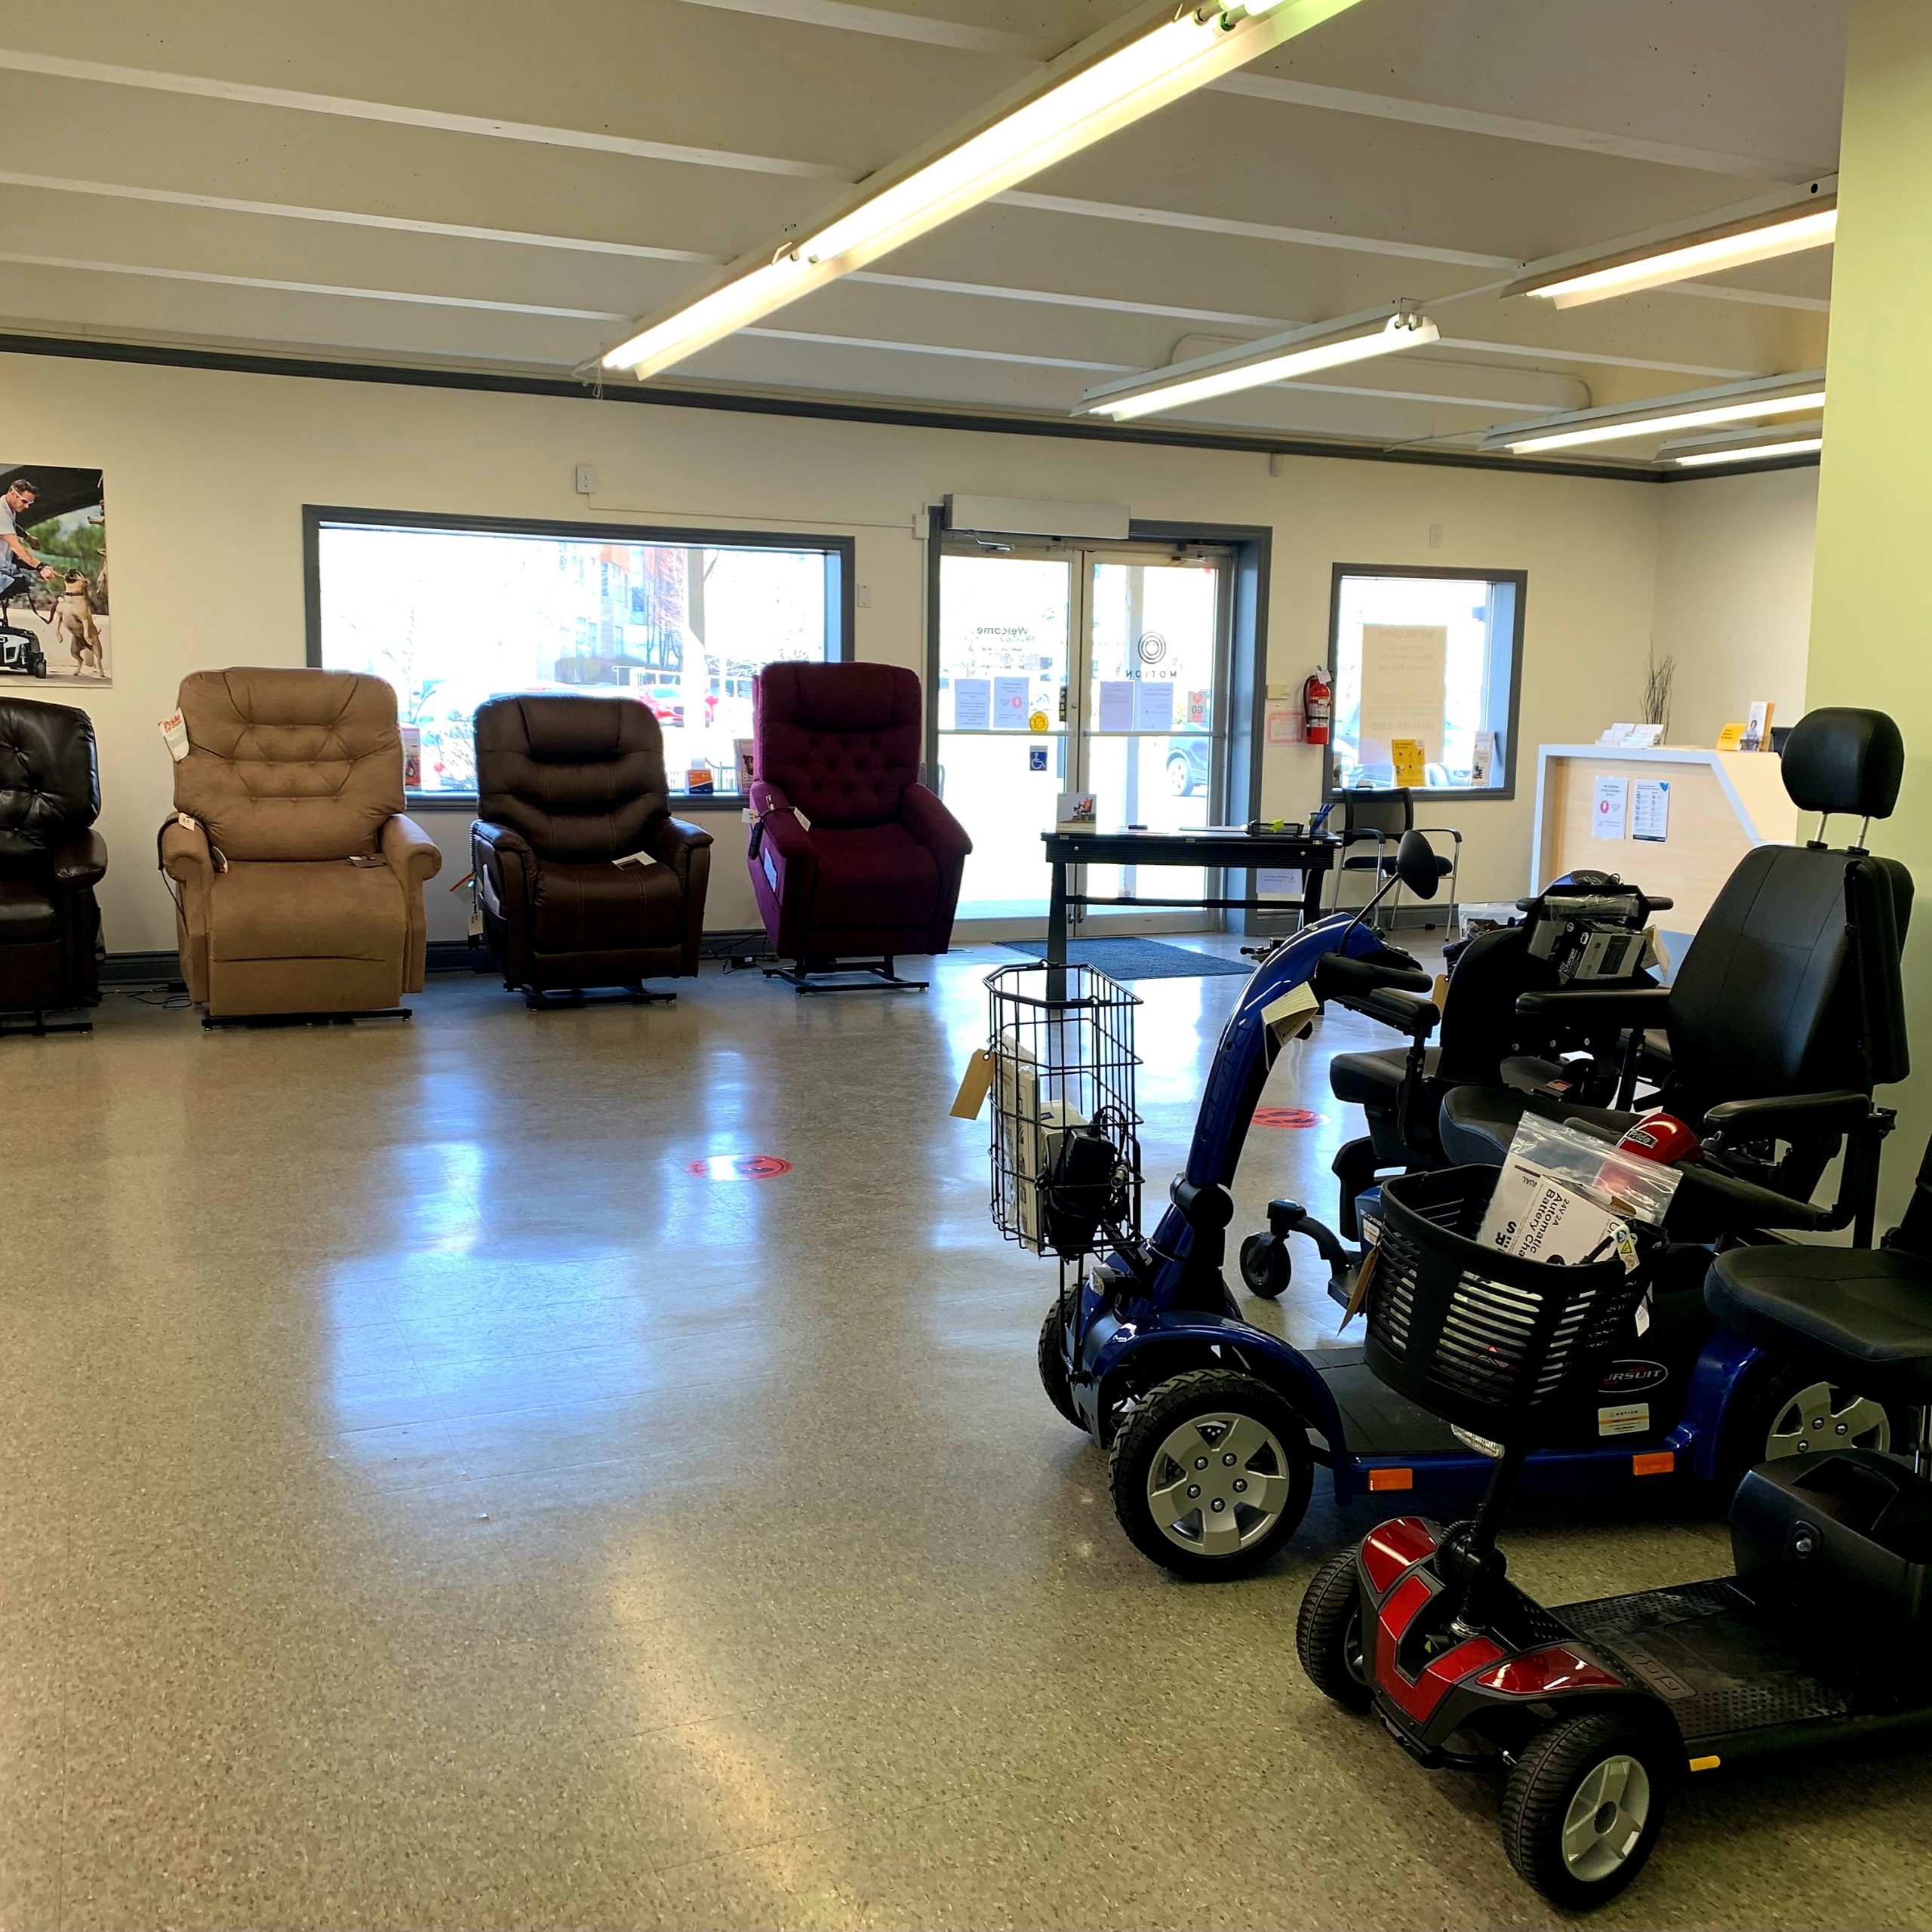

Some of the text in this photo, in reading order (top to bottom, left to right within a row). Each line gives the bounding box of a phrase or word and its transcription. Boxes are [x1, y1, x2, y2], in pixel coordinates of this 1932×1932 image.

[1563, 948, 1576, 973] Charger
[1628, 1131, 1651, 1143] Pride
[1529, 1188, 1555, 1232] Battery
[1529, 1192, 1563, 1254] Automatic
[1552, 1198, 1571, 1226] 24V 2A
